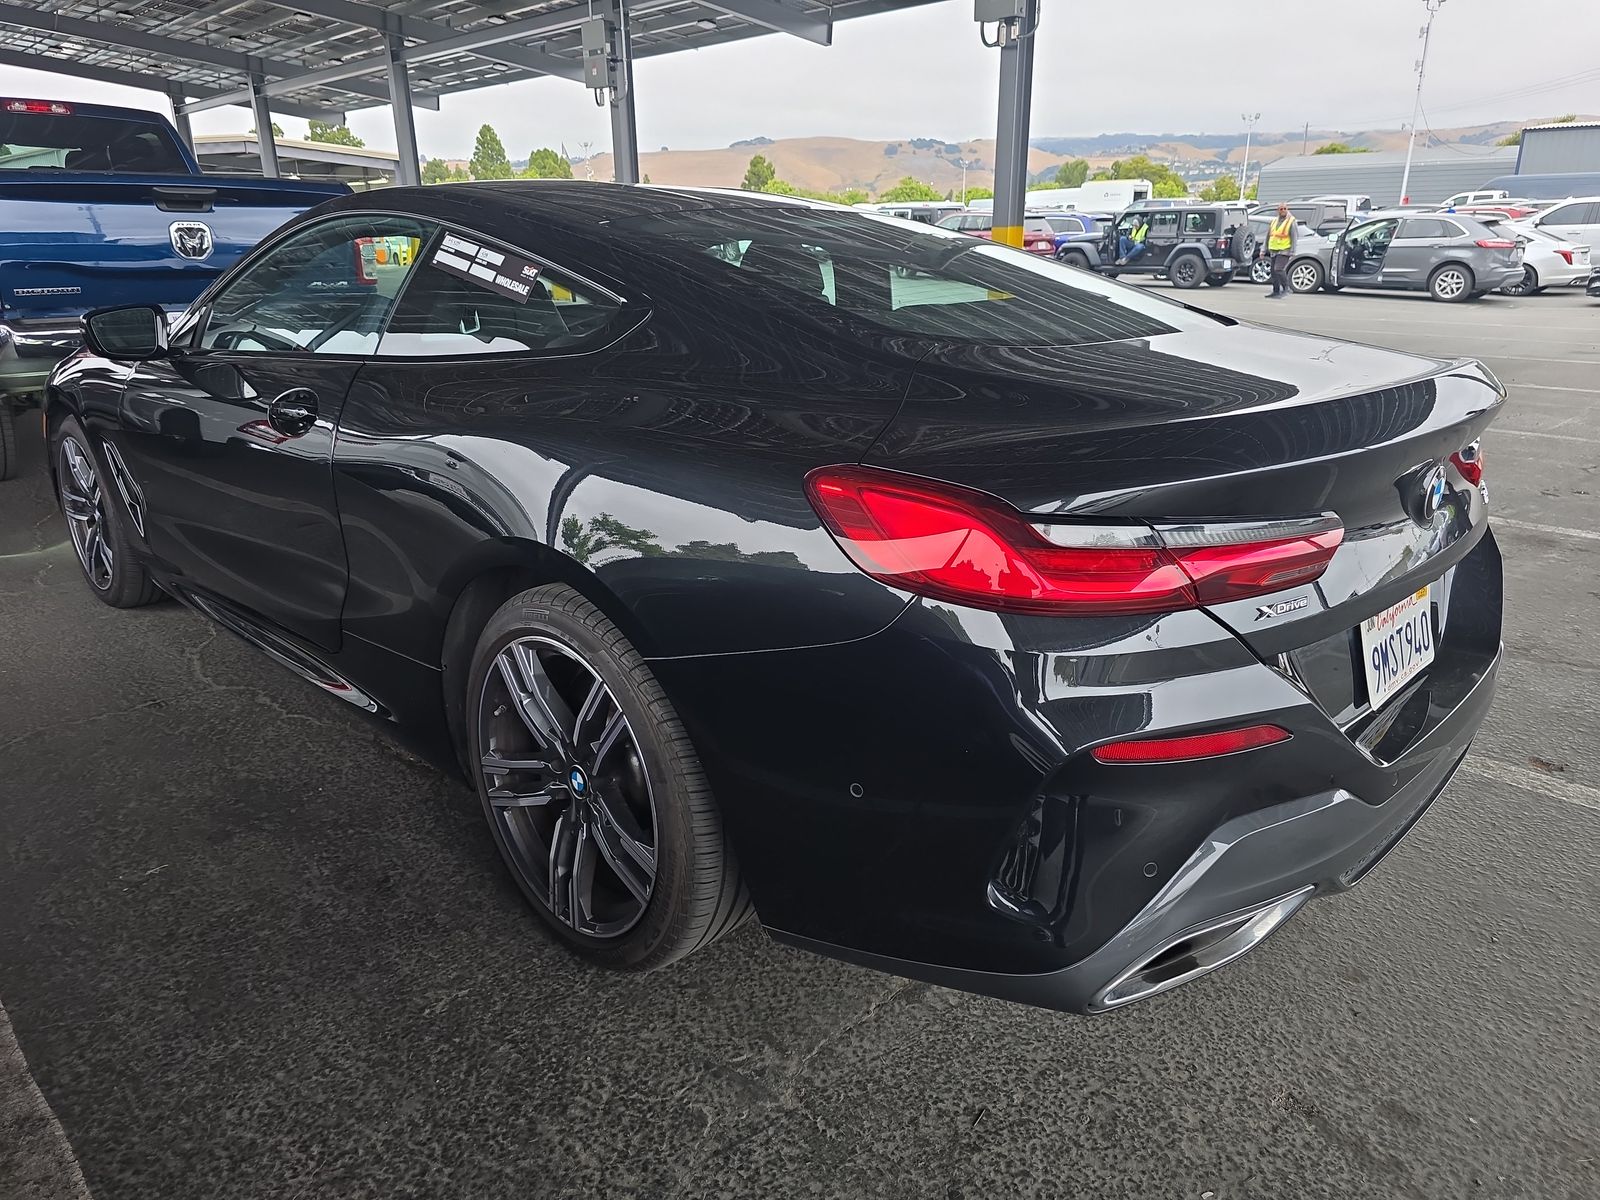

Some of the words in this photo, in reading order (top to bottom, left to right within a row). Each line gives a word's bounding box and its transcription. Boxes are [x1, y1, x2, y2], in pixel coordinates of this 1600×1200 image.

[495, 274, 530, 296] WHOLESALE
[1375, 596, 1418, 631] California
[1372, 611, 1430, 694] 9MST940
